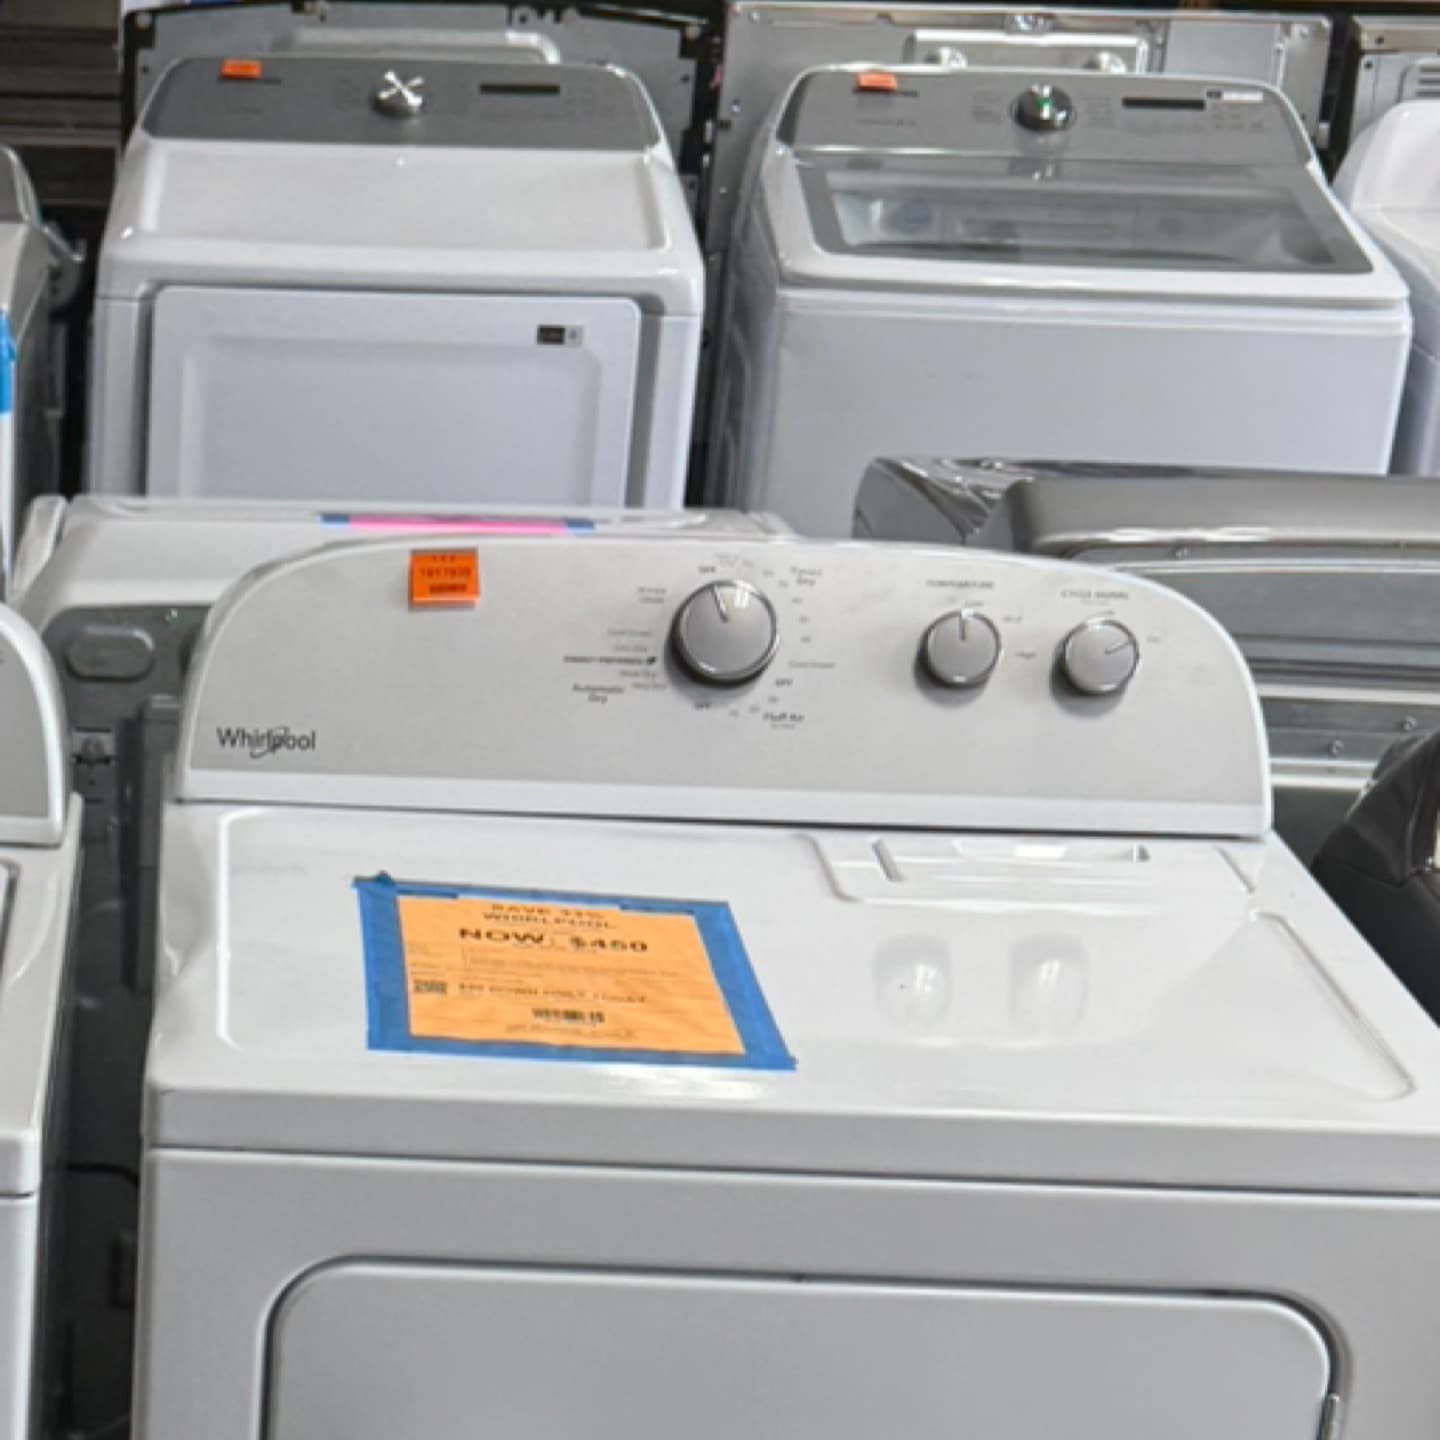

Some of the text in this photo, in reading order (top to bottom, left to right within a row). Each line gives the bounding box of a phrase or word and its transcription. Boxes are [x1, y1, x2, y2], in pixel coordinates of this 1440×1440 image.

[216, 725, 316, 760] Whirlpool
[459, 927, 648, 953] NOW: $450
